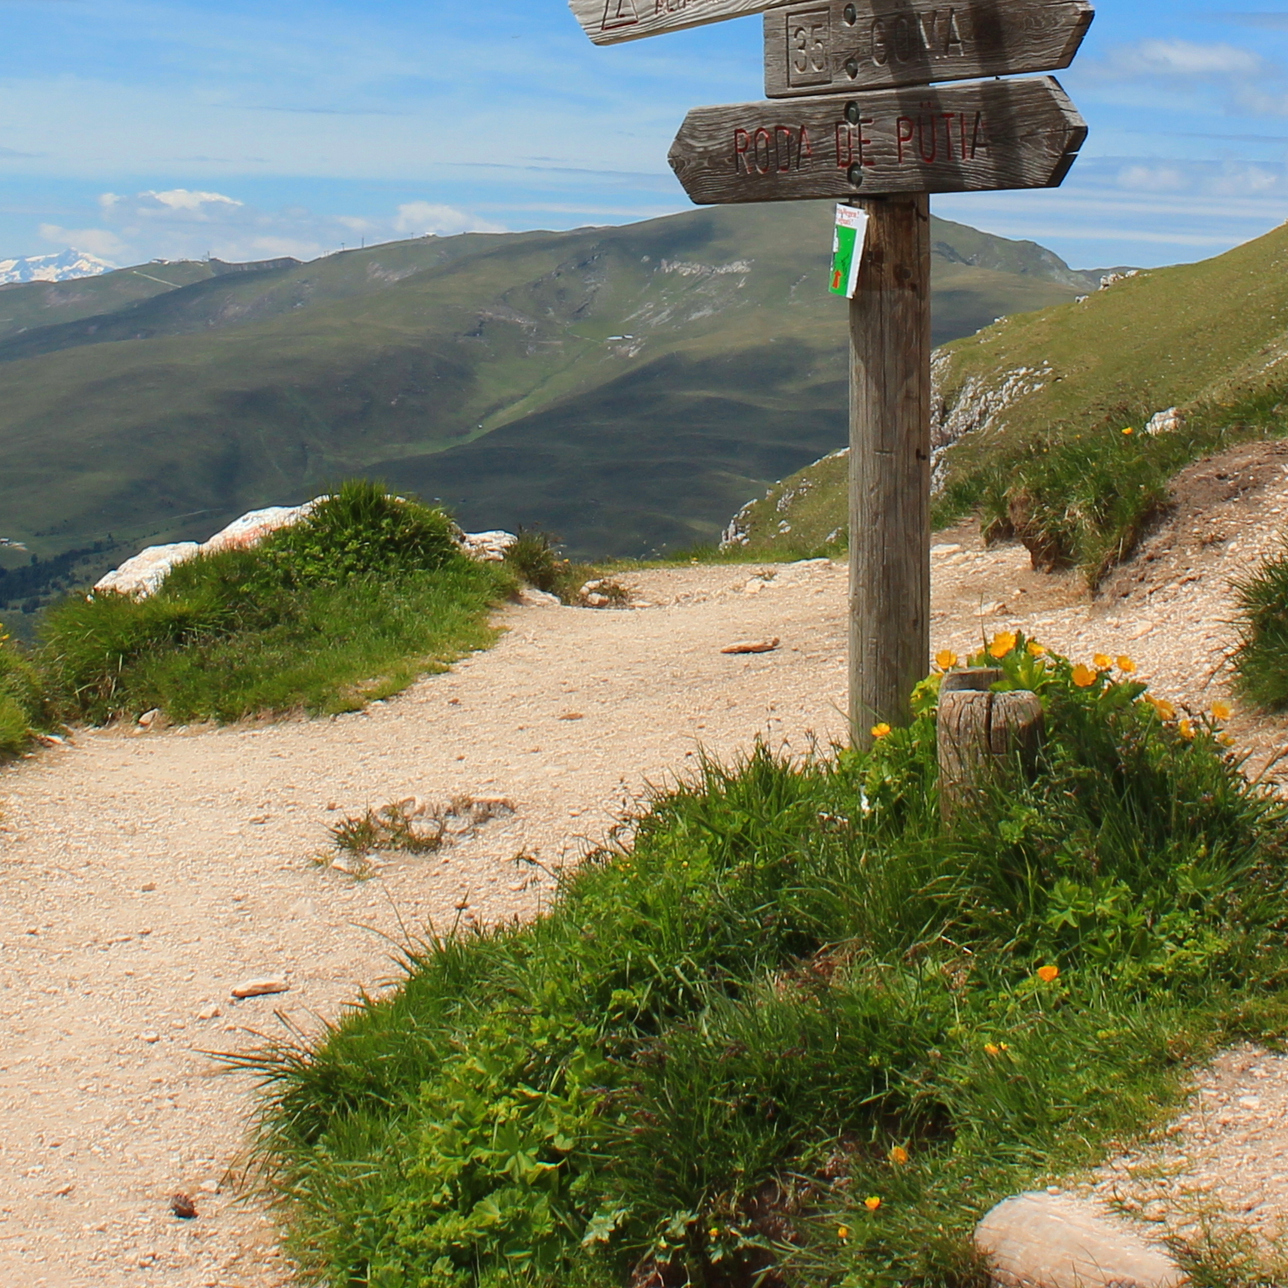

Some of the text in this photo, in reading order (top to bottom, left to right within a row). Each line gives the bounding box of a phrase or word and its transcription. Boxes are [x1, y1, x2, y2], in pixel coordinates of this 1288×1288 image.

[792, 22, 826, 74] 35
[733, 101, 989, 175] RODA DE PÜTIA
